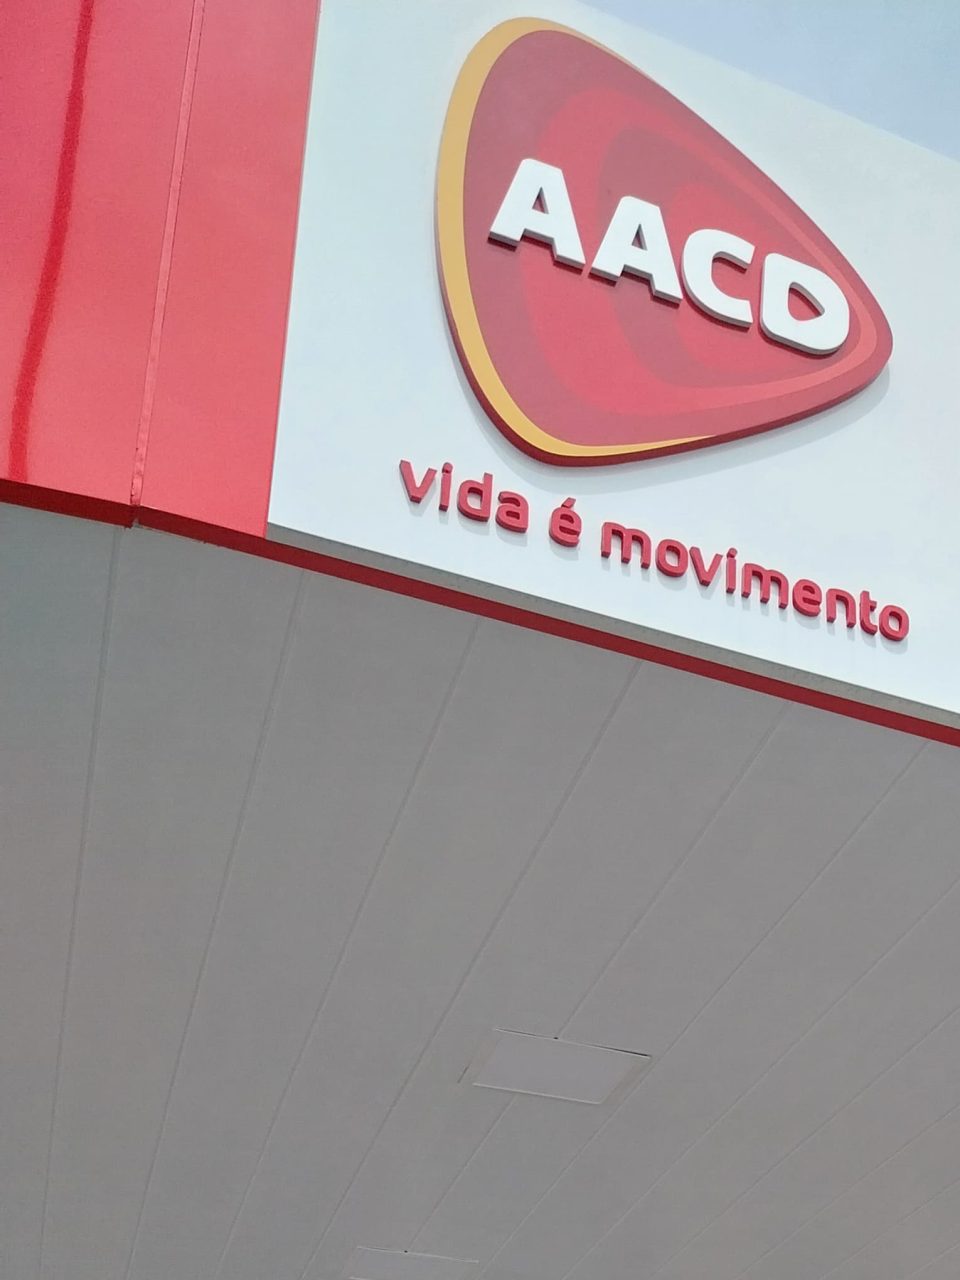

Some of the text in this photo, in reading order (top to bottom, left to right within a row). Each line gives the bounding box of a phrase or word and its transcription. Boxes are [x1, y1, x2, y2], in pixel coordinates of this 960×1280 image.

[488, 157, 850, 356] AACD
[399, 459, 910, 642] vida é movimento
